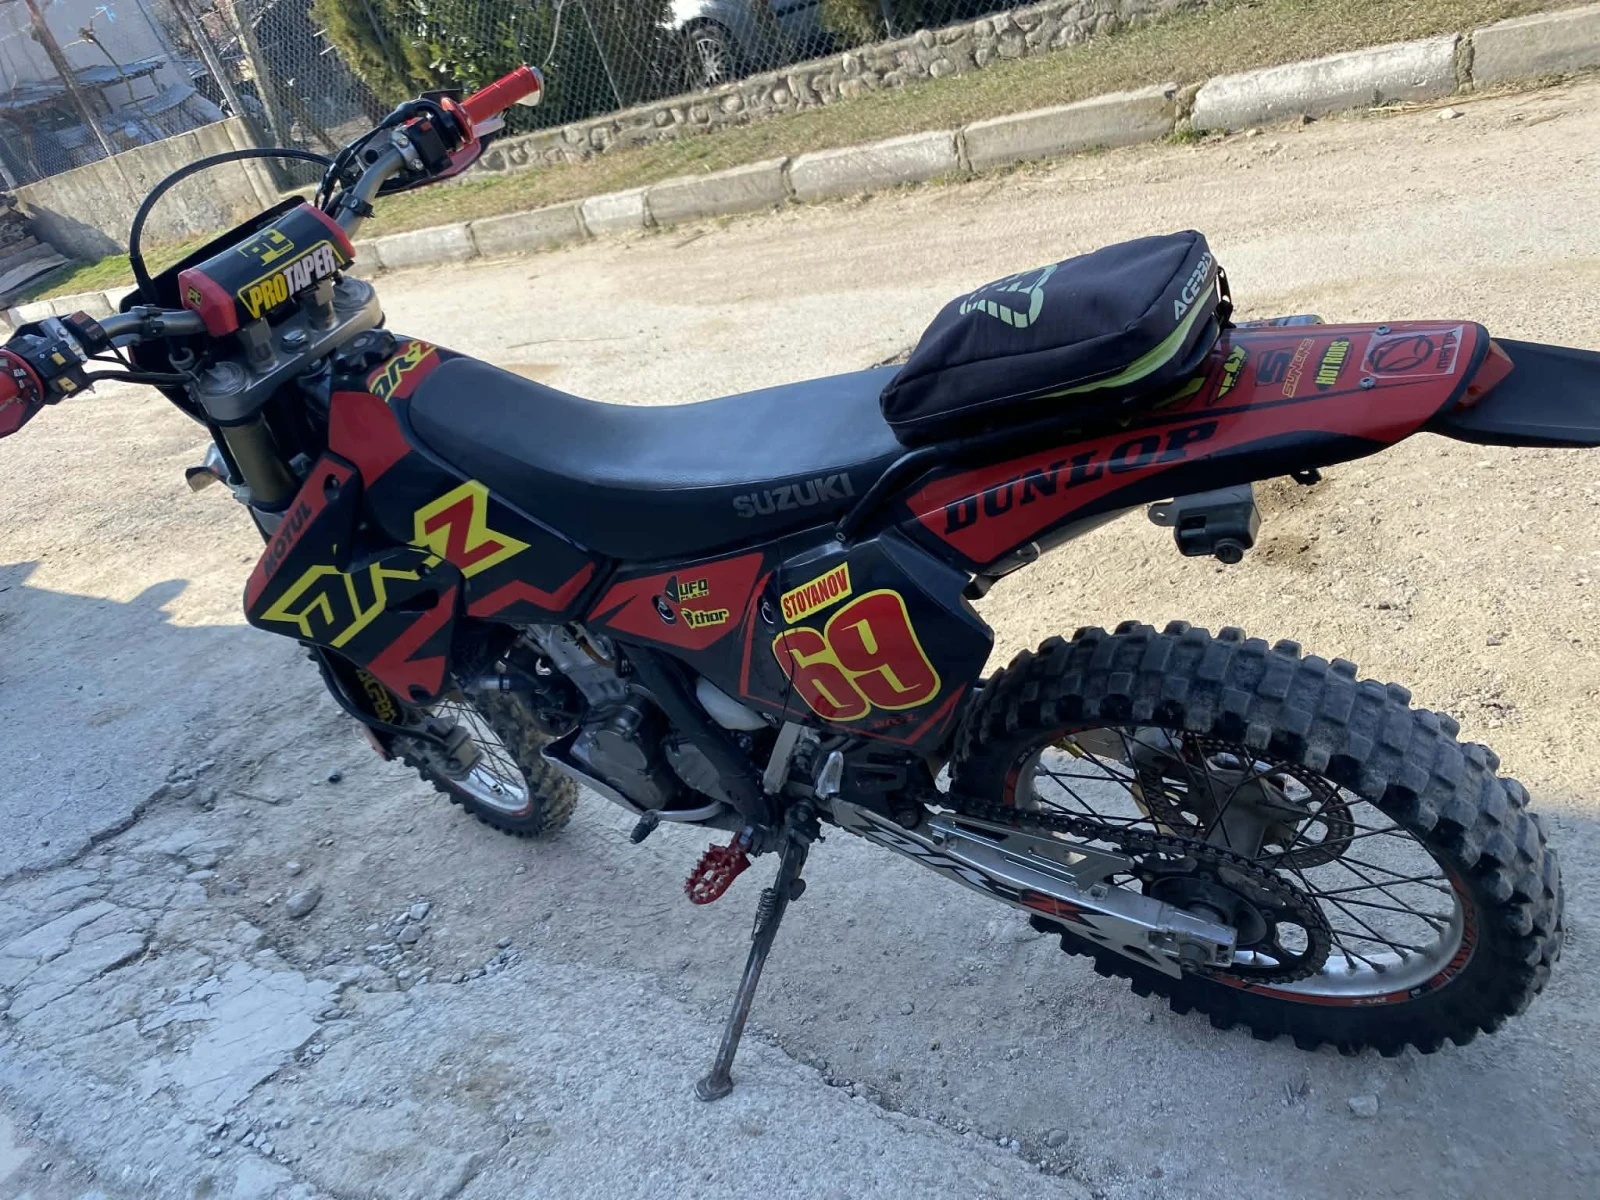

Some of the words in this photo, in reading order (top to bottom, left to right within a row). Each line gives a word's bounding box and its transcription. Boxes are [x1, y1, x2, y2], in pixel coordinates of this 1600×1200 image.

[1315, 363, 1340, 385] HOT
[1322, 341, 1350, 364] RODS
[733, 473, 856, 518] SUZUKI
[944, 420, 1219, 535] DUNLOP
[264, 503, 312, 580] MOTUL
[680, 579, 708, 596] UFO
[783, 568, 850, 620] STOYANOV
[694, 609, 728, 625] thor
[773, 588, 941, 721] 69
